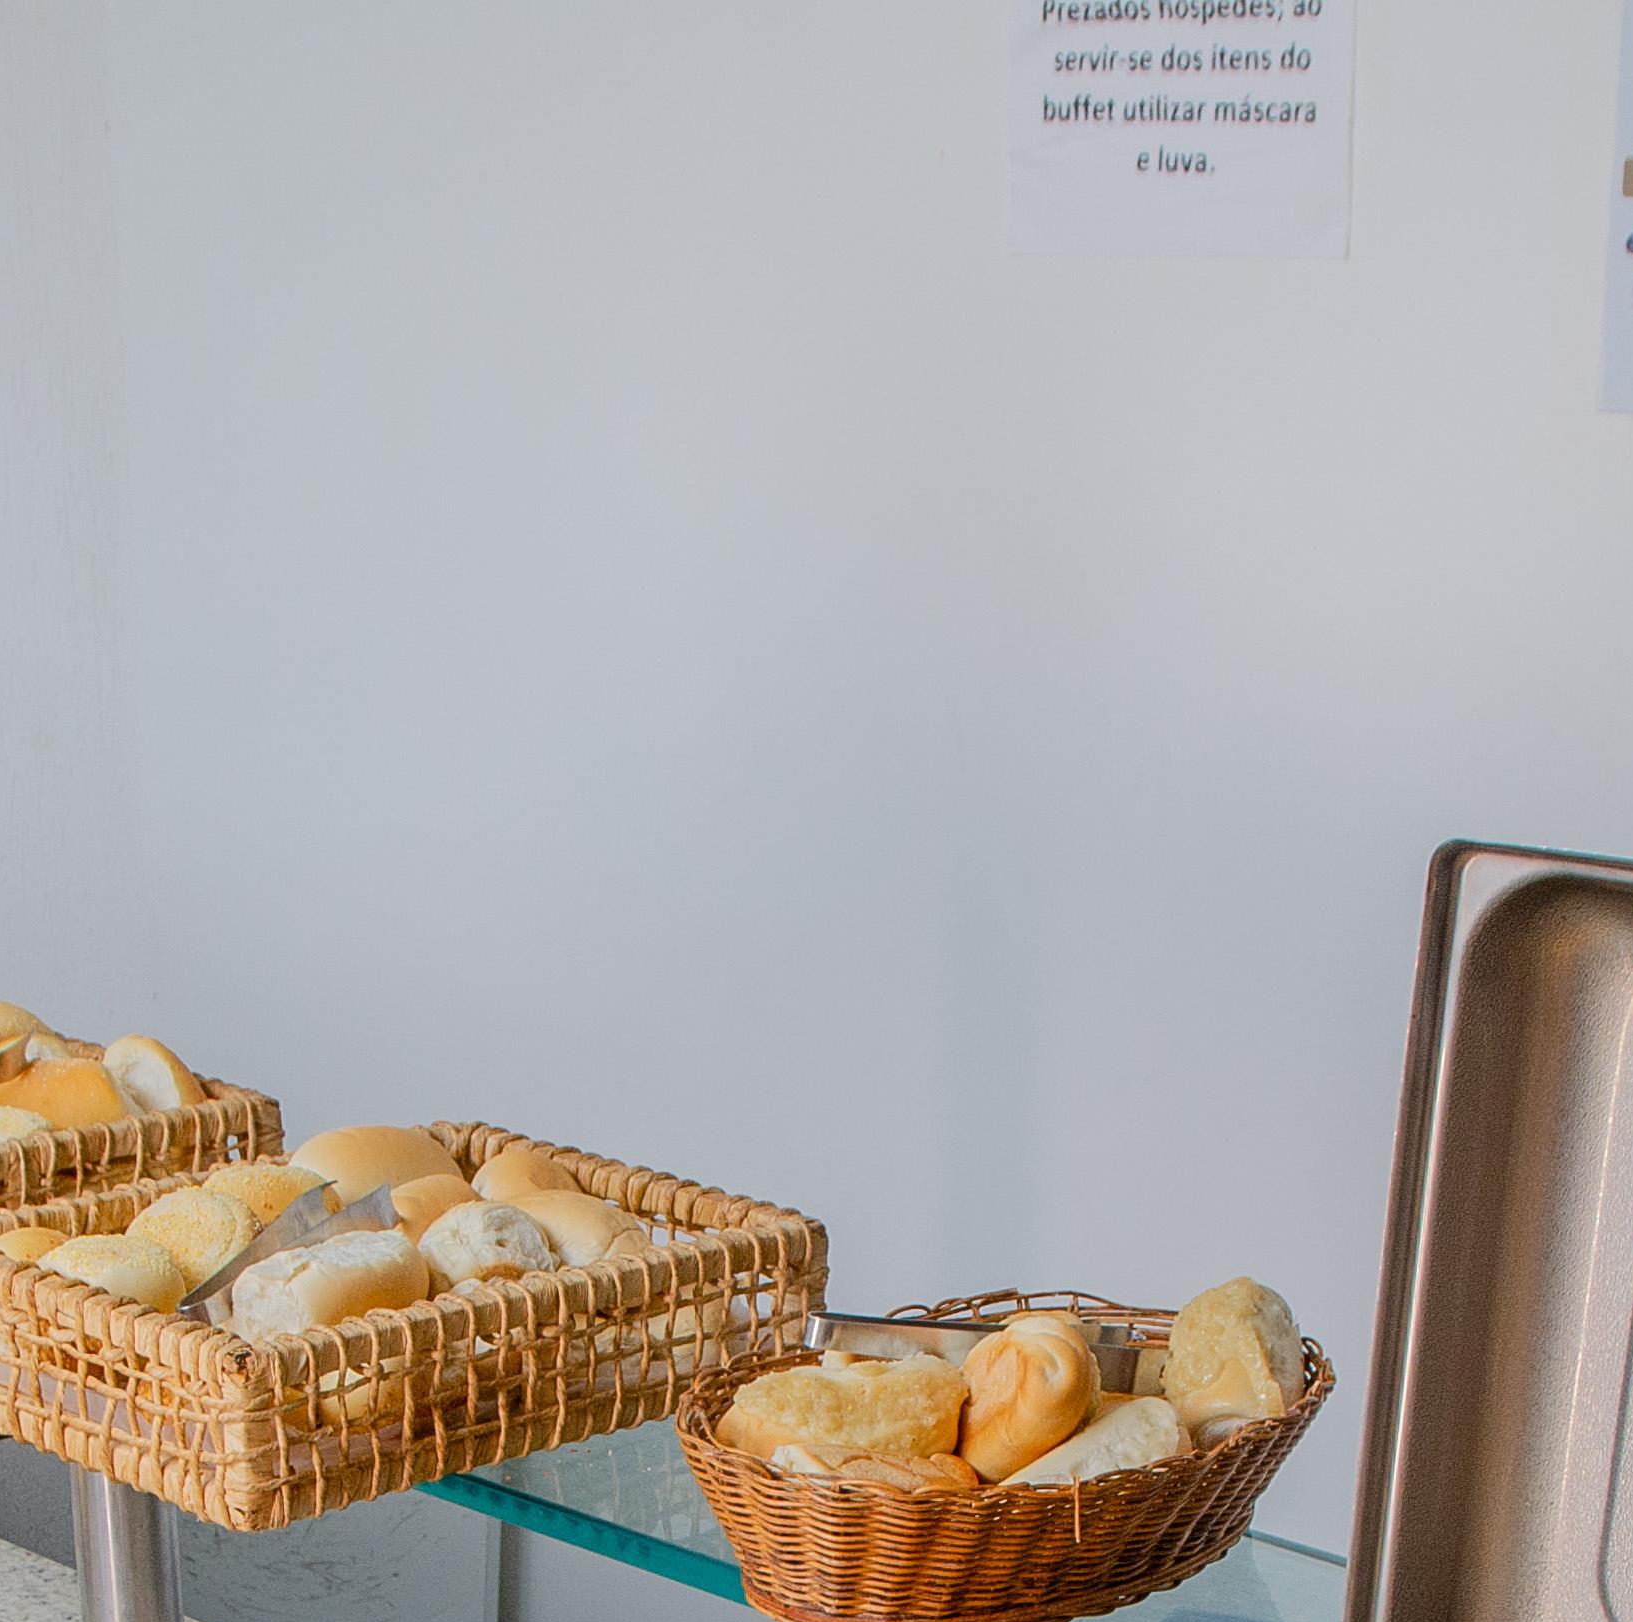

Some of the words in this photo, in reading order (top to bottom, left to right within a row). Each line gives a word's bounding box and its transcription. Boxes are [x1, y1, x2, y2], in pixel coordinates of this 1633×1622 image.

[1293, 0, 1323, 17] ao
[1054, 44, 1152, 72] servir-se
[1161, 43, 1203, 71] dos
[1211, 44, 1272, 71] itens
[1280, 42, 1312, 72] do
[1042, 94, 1115, 121] buffet
[1123, 94, 1206, 122] utilizar
[1214, 94, 1317, 123] máscara
[1136, 151, 1150, 172] e
[1158, 145, 1215, 173] luva.
